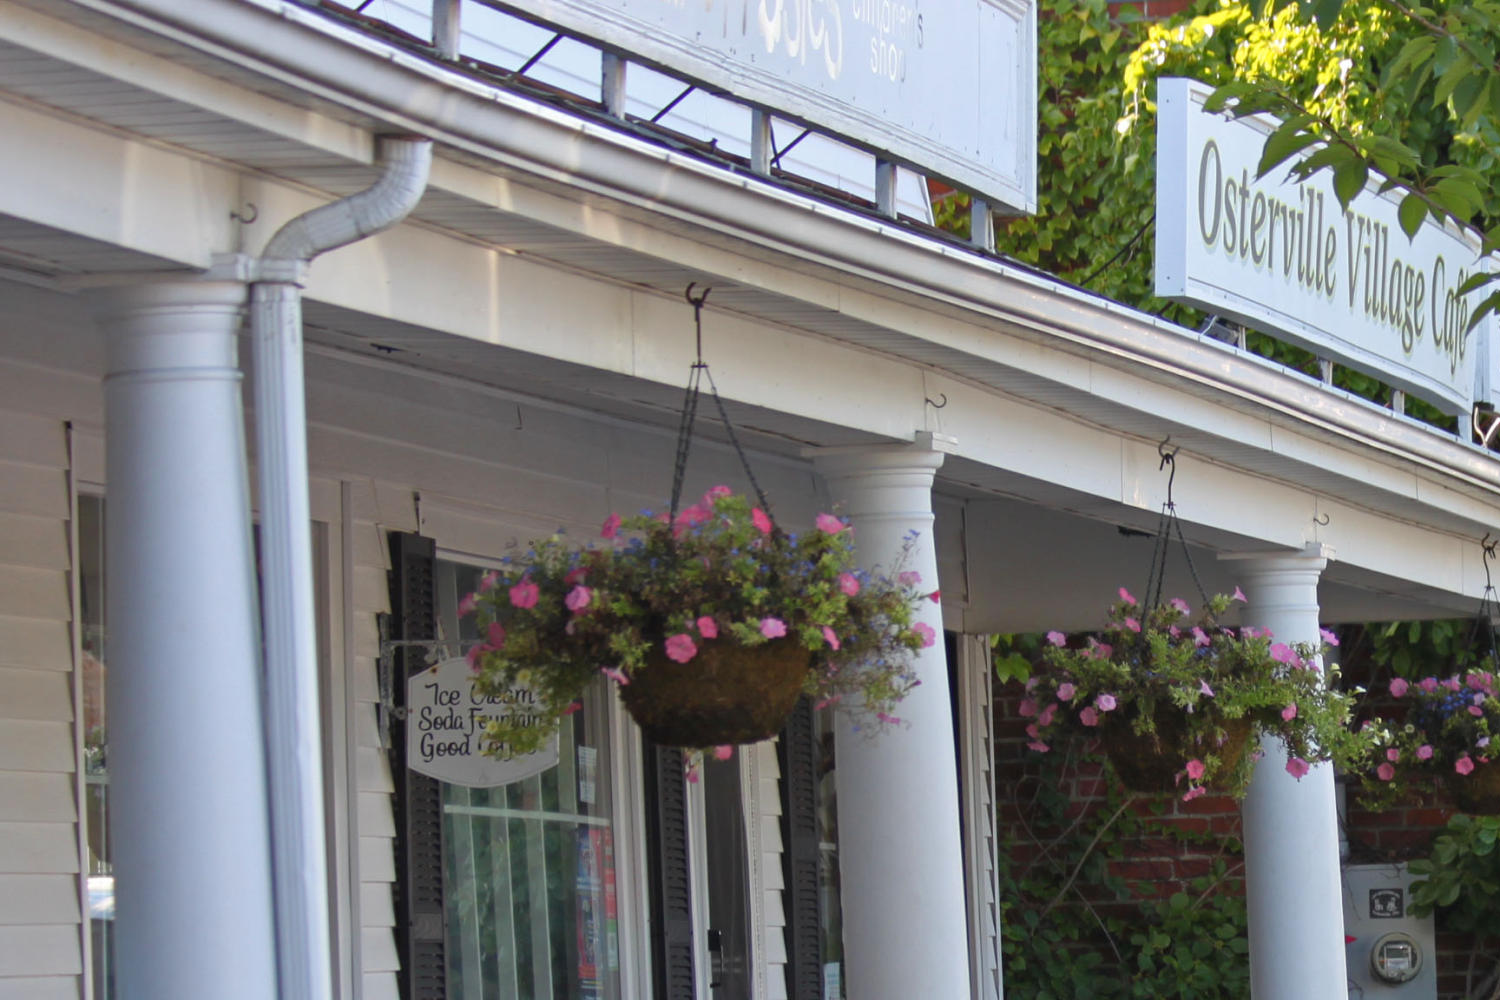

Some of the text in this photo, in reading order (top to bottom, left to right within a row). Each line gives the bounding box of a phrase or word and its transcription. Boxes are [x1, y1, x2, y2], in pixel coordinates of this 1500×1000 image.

[1198, 139, 1337, 297] Osterville
[1344, 208, 1425, 354] Village
[424, 682, 461, 706] Ice
[418, 706, 465, 731] Soda
[420, 732, 472, 763] Good
